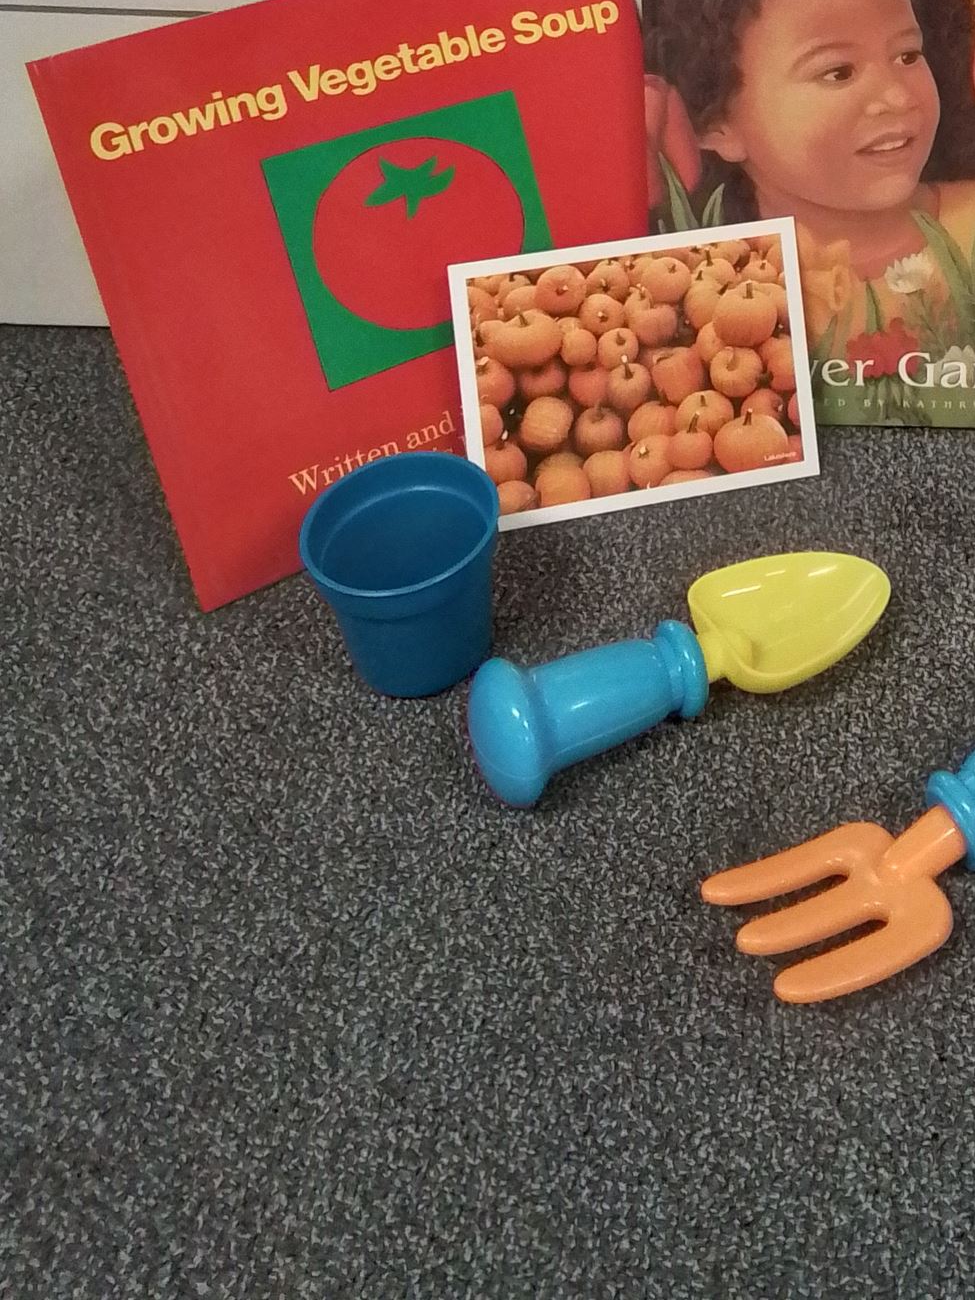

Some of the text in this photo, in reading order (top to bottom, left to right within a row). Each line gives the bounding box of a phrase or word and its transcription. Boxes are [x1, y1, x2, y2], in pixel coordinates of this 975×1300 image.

[89, 0, 620, 161] Growing Vegetable Soup
[864, 399, 885, 407] BY
[288, 410, 456, 496] Written and
